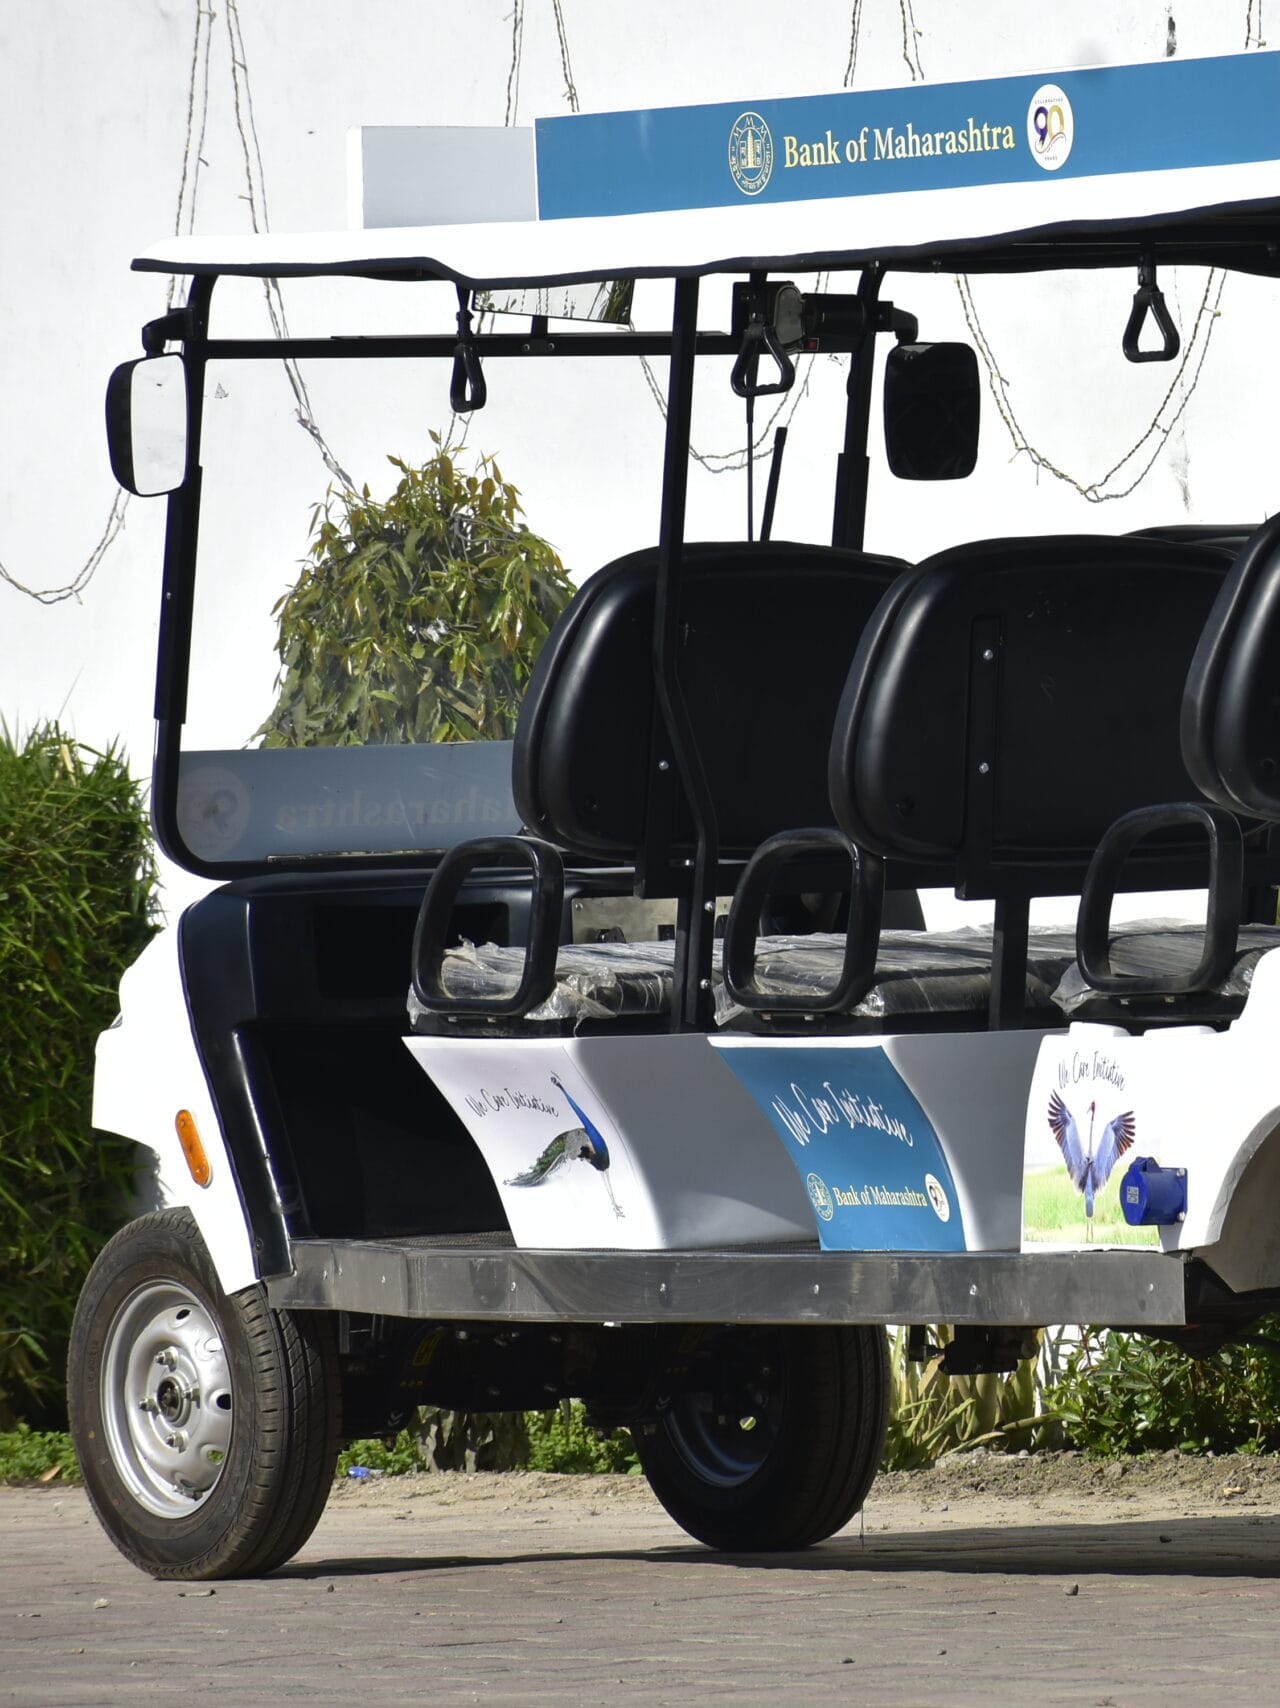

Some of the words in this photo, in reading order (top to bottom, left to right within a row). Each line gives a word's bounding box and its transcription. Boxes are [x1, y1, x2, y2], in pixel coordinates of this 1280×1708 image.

[783, 130, 842, 168] Bank
[845, 126, 869, 163] of
[873, 117, 1016, 161] Maharashtra
[1034, 105, 1065, 149] 90
[1058, 1058, 1070, 1089] We
[1072, 1051, 1090, 1083] Care
[464, 1094, 488, 1117] We
[480, 1088, 510, 1112] Care
[771, 1094, 811, 1147] We
[790, 1082, 840, 1134] Care
[832, 1184, 861, 1207] Bank
[860, 1184, 872, 1206] of
[870, 1184, 928, 1207] Maharashtra
